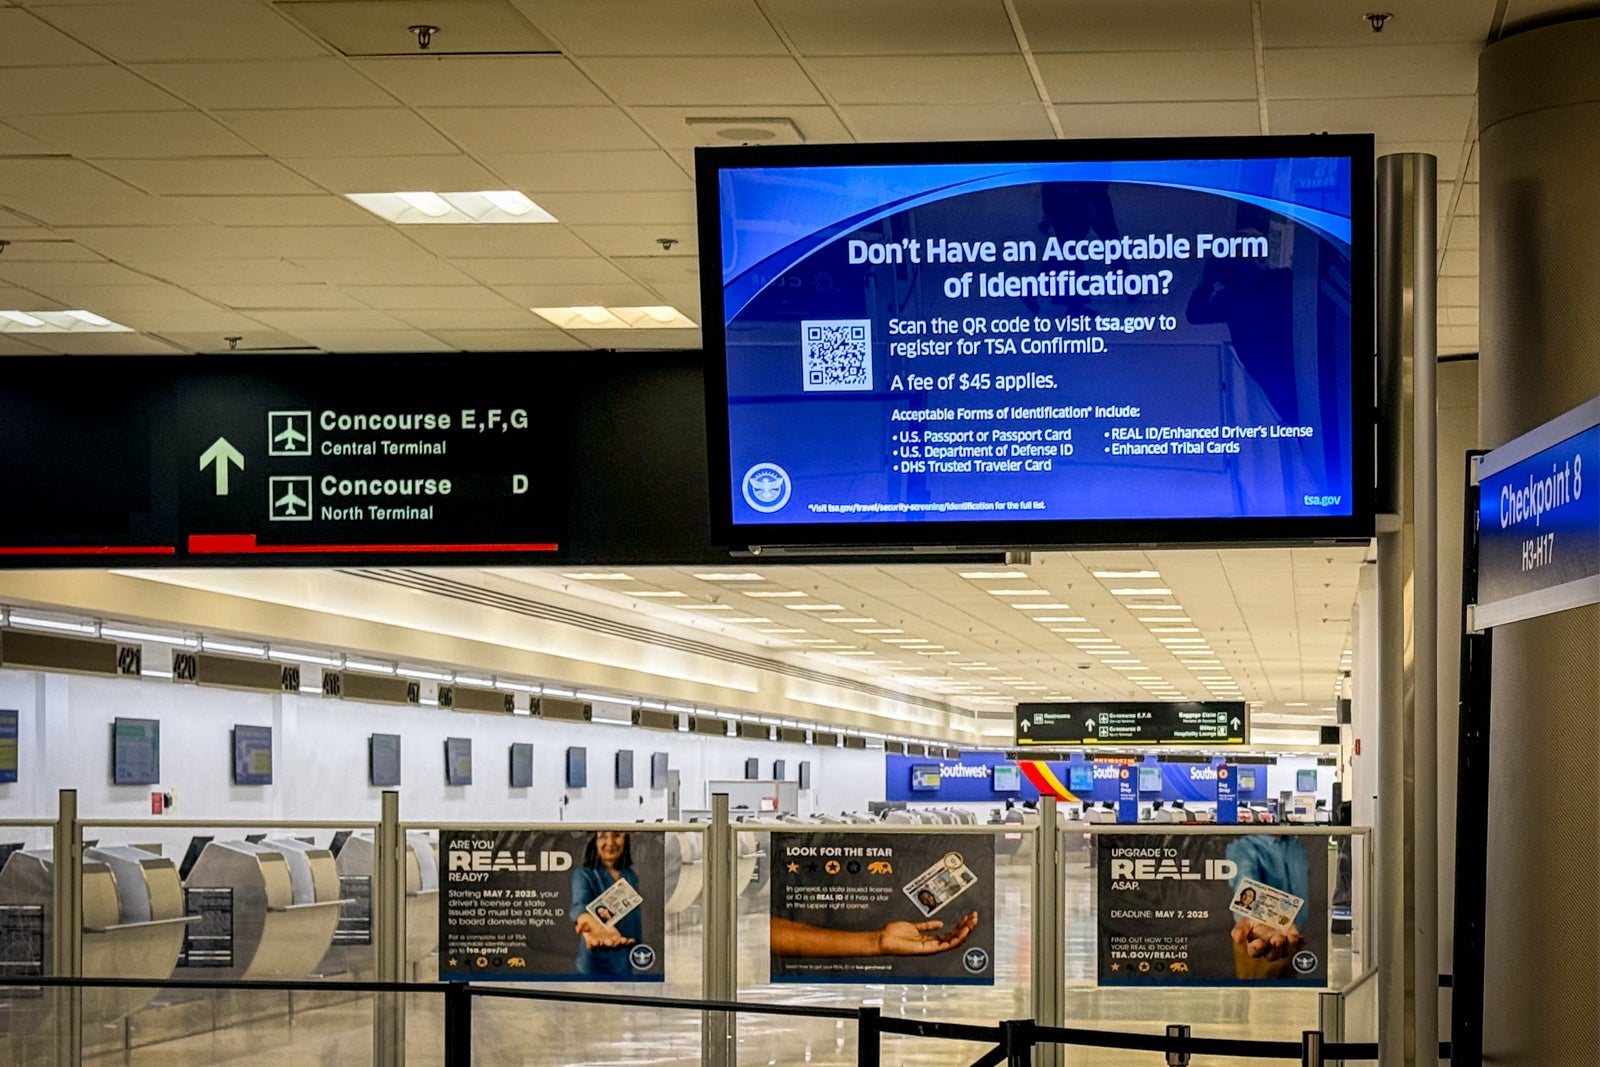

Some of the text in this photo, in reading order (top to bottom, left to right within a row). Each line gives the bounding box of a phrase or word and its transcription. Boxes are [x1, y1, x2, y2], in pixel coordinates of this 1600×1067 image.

[848, 234, 1268, 264] Don't Have an Acceptable Form
[944, 270, 1173, 298] of Identification?
[889, 315, 1176, 335] Scan the QR code to visit tsa.gov to
[890, 336, 1108, 358] register for TSA ConfirmID.
[891, 372, 1057, 393] A fee of $45 applies.
[320, 409, 528, 433] Concourse E,F,G
[892, 409, 954, 422] Acceptable
[957, 408, 993, 419] Forms
[997, 408, 1009, 419] of
[900, 429, 1071, 444] U.S. Passport or Passport Card
[1112, 428, 1142, 440] REAL
[1146, 427, 1219, 440] ID/Enhanced
[1271, 425, 1313, 438] License
[321, 440, 446, 455] Central Terminal
[900, 444, 1073, 459] U.S. Department of Defense ID
[1112, 441, 1240, 454] Enhanced Tribal Cards
[901, 459, 1052, 473] DHS Trusted Traveler Card
[321, 474, 529, 496] Concourse D
[1501, 454, 1582, 529] Checkpoint 8
[995, 502, 1005, 510] for
[1007, 502, 1019, 510] the
[1020, 501, 1031, 510] full
[1033, 501, 1046, 510] list.
[1304, 495, 1341, 506] tsa.gov
[322, 505, 433, 520] North Terminal
[1522, 533, 1554, 572] H3-H17
[118, 647, 141, 675] 421
[174, 654, 196, 681] 420
[282, 666, 300, 690] 419
[450, 840, 494, 849] ARE YOU
[787, 847, 892, 857] LOOK FOR THE STAR
[1111, 848, 1177, 857] UPGRADE TO
[449, 851, 572, 871] REAL ID
[1111, 859, 1237, 880] REAL ID
[449, 873, 489, 882] READY?
[1111, 881, 1140, 890] ASAP.
[449, 890, 481, 899] Starting
[483, 890, 502, 898] MAY
[505, 890, 513, 898] 7,
